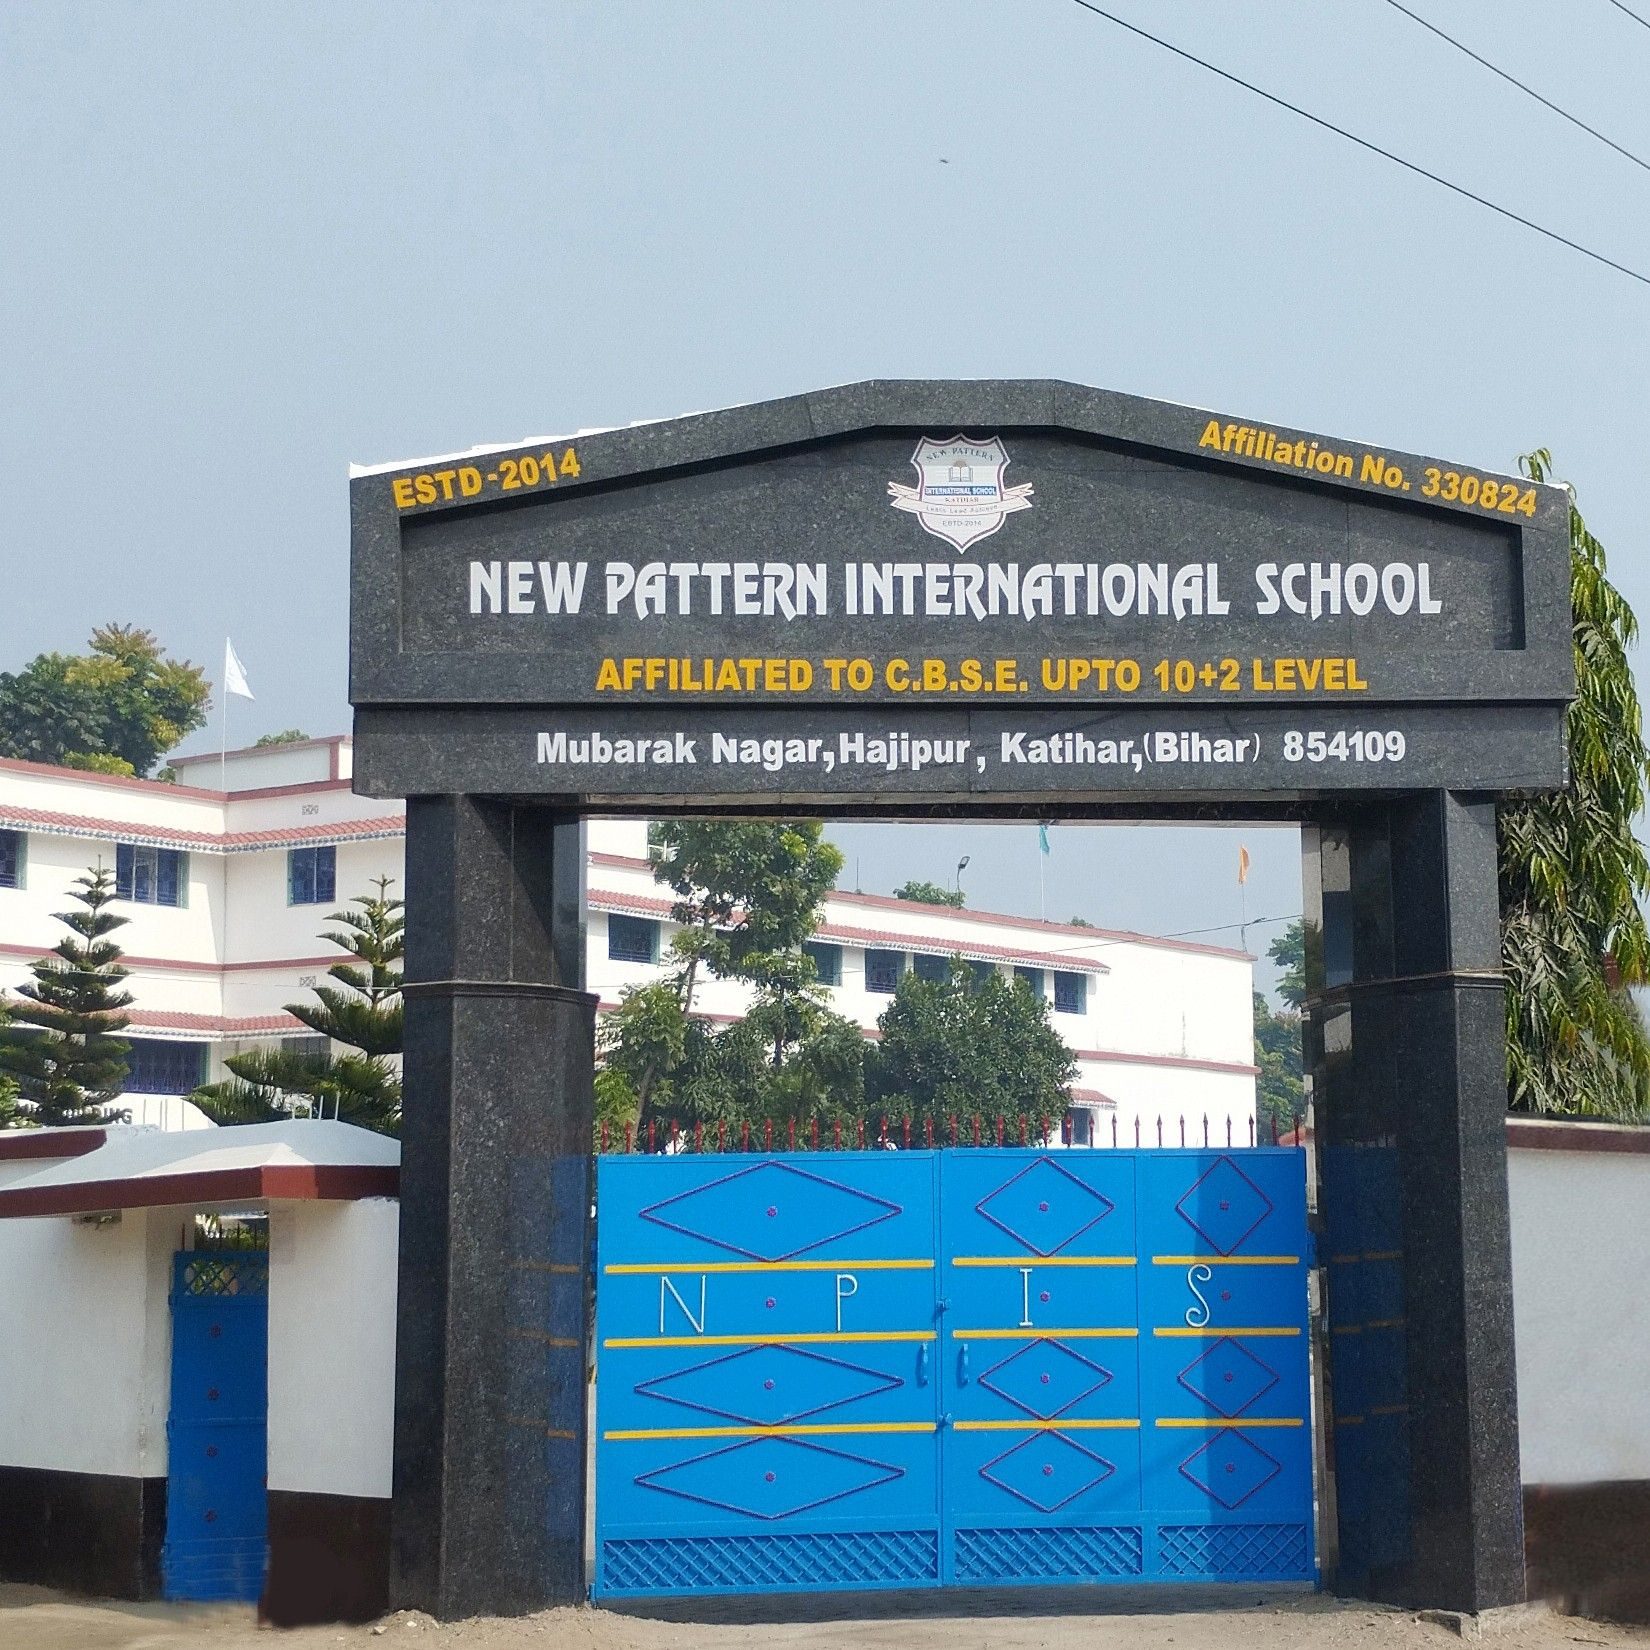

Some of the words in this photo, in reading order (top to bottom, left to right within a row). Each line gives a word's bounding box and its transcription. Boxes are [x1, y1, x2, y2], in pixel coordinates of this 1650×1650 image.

[926, 449, 947, 462] NEW
[1199, 420, 1353, 478] Affiliation
[1360, 454, 1410, 491] No.
[1421, 468, 1537, 517] 330824
[972, 487, 996, 495] SCHOOL
[469, 560, 588, 614] NEW
[605, 561, 828, 622] PATTERN
[845, 562, 1231, 622] INTERNATIONAL
[1255, 562, 1443, 622] SCHOOL
[595, 657, 814, 693] AFFILIATED
[823, 658, 874, 692] TO
[885, 658, 1029, 692] C.B.S.E.
[1041, 658, 1141, 693] UPTO
[1154, 658, 1241, 693] 10+2
[1253, 658, 1368, 692] LEVEL
[536, 732, 697, 764] Mubarak
[1283, 731, 1406, 763] 854109
[659, 1274, 707, 1334] N
[836, 1274, 859, 1332] P
[1018, 1268, 1034, 1327] I
[1185, 1264, 1212, 1328] S
